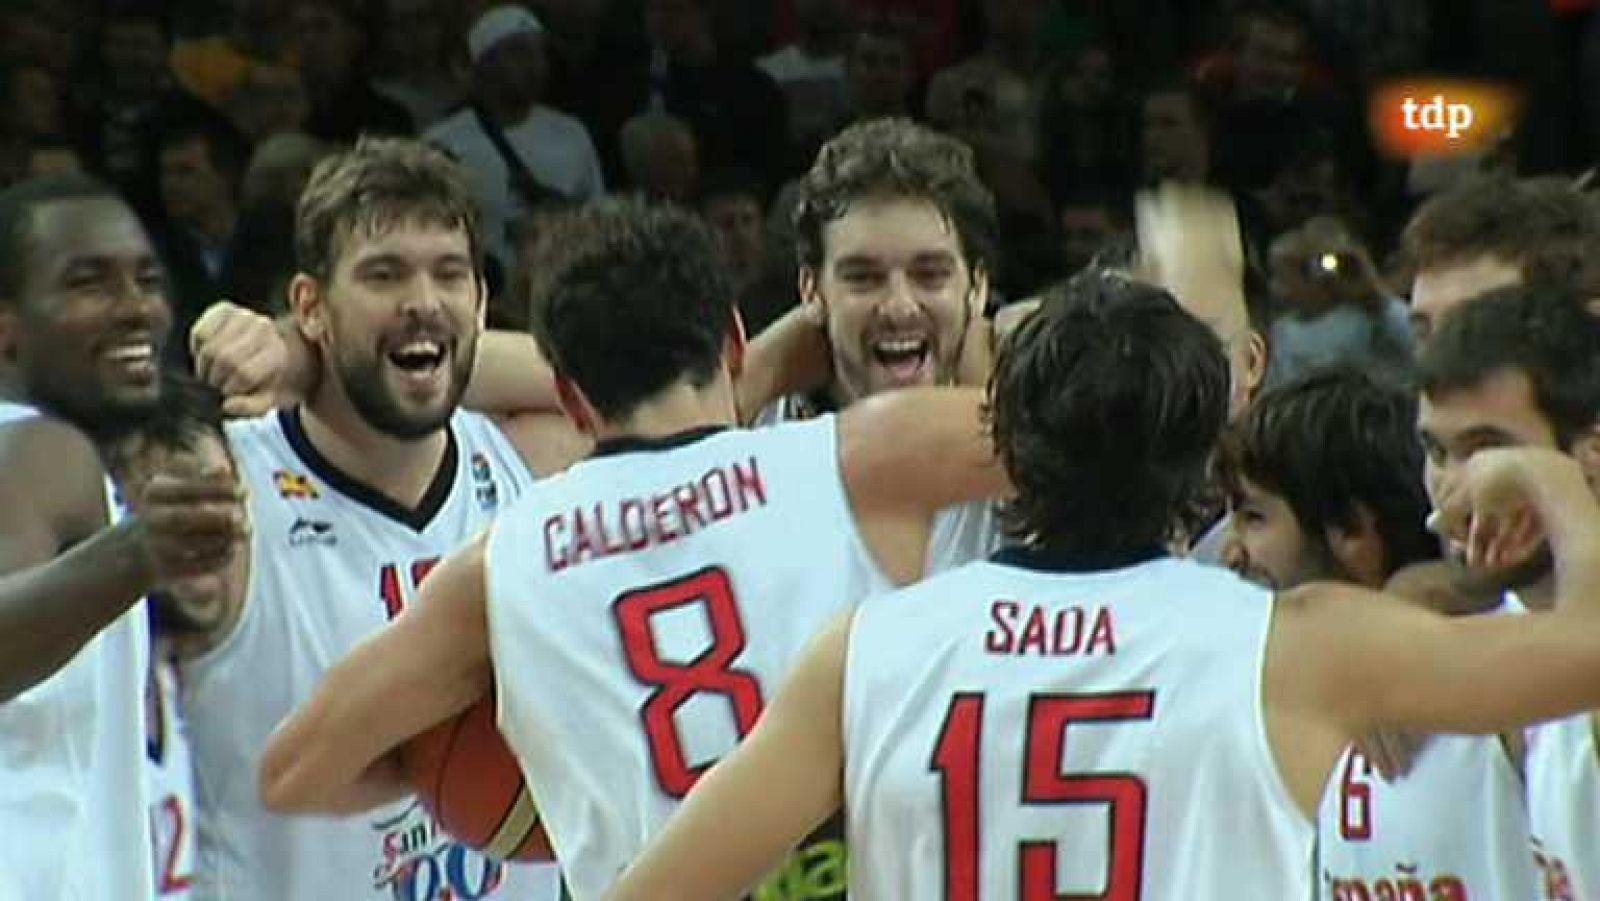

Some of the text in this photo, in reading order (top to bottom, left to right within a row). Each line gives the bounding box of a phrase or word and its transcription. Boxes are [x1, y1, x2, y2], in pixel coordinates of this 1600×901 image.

[543, 456, 768, 571] CALDERON
[612, 566, 765, 799] 8
[984, 599, 1116, 655] SADA
[929, 689, 1155, 901] 15
[1339, 748, 1371, 841] 6
